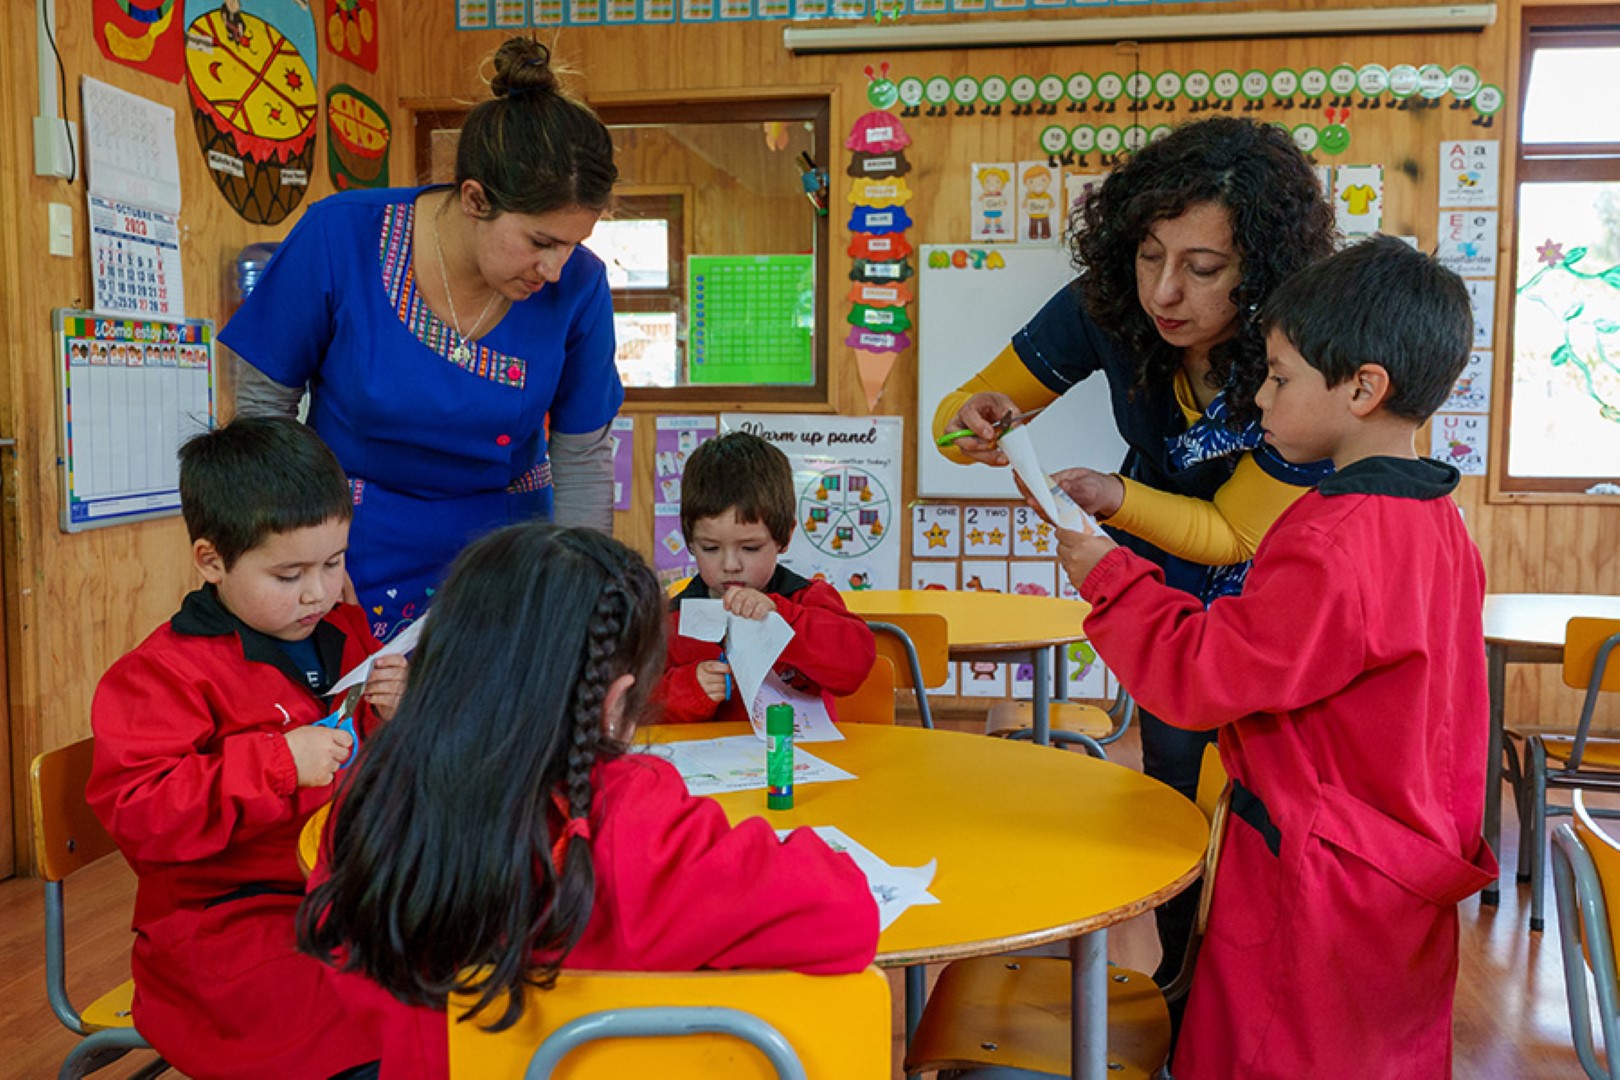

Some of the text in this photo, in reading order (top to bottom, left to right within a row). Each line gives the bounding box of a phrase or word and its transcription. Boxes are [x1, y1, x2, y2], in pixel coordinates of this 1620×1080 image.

[1192, 78, 1204, 87] 10
[1221, 78, 1231, 86] 11
[1482, 92, 1494, 101] 20
[1450, 143, 1486, 156] A a
[124, 216, 148, 236] 2023
[1450, 213, 1487, 227] E e
[134, 325, 160, 343] estoy
[162, 326, 187, 345] hoy?
[1444, 416, 1478, 428] U u
[741, 420, 877, 446] Warm up panel
[917, 507, 957, 523] 1 ONE
[967, 507, 1007, 524] 2 TWO
[1016, 508, 1028, 525] 3
[402, 603, 415, 619] C
[373, 622, 388, 638] B
